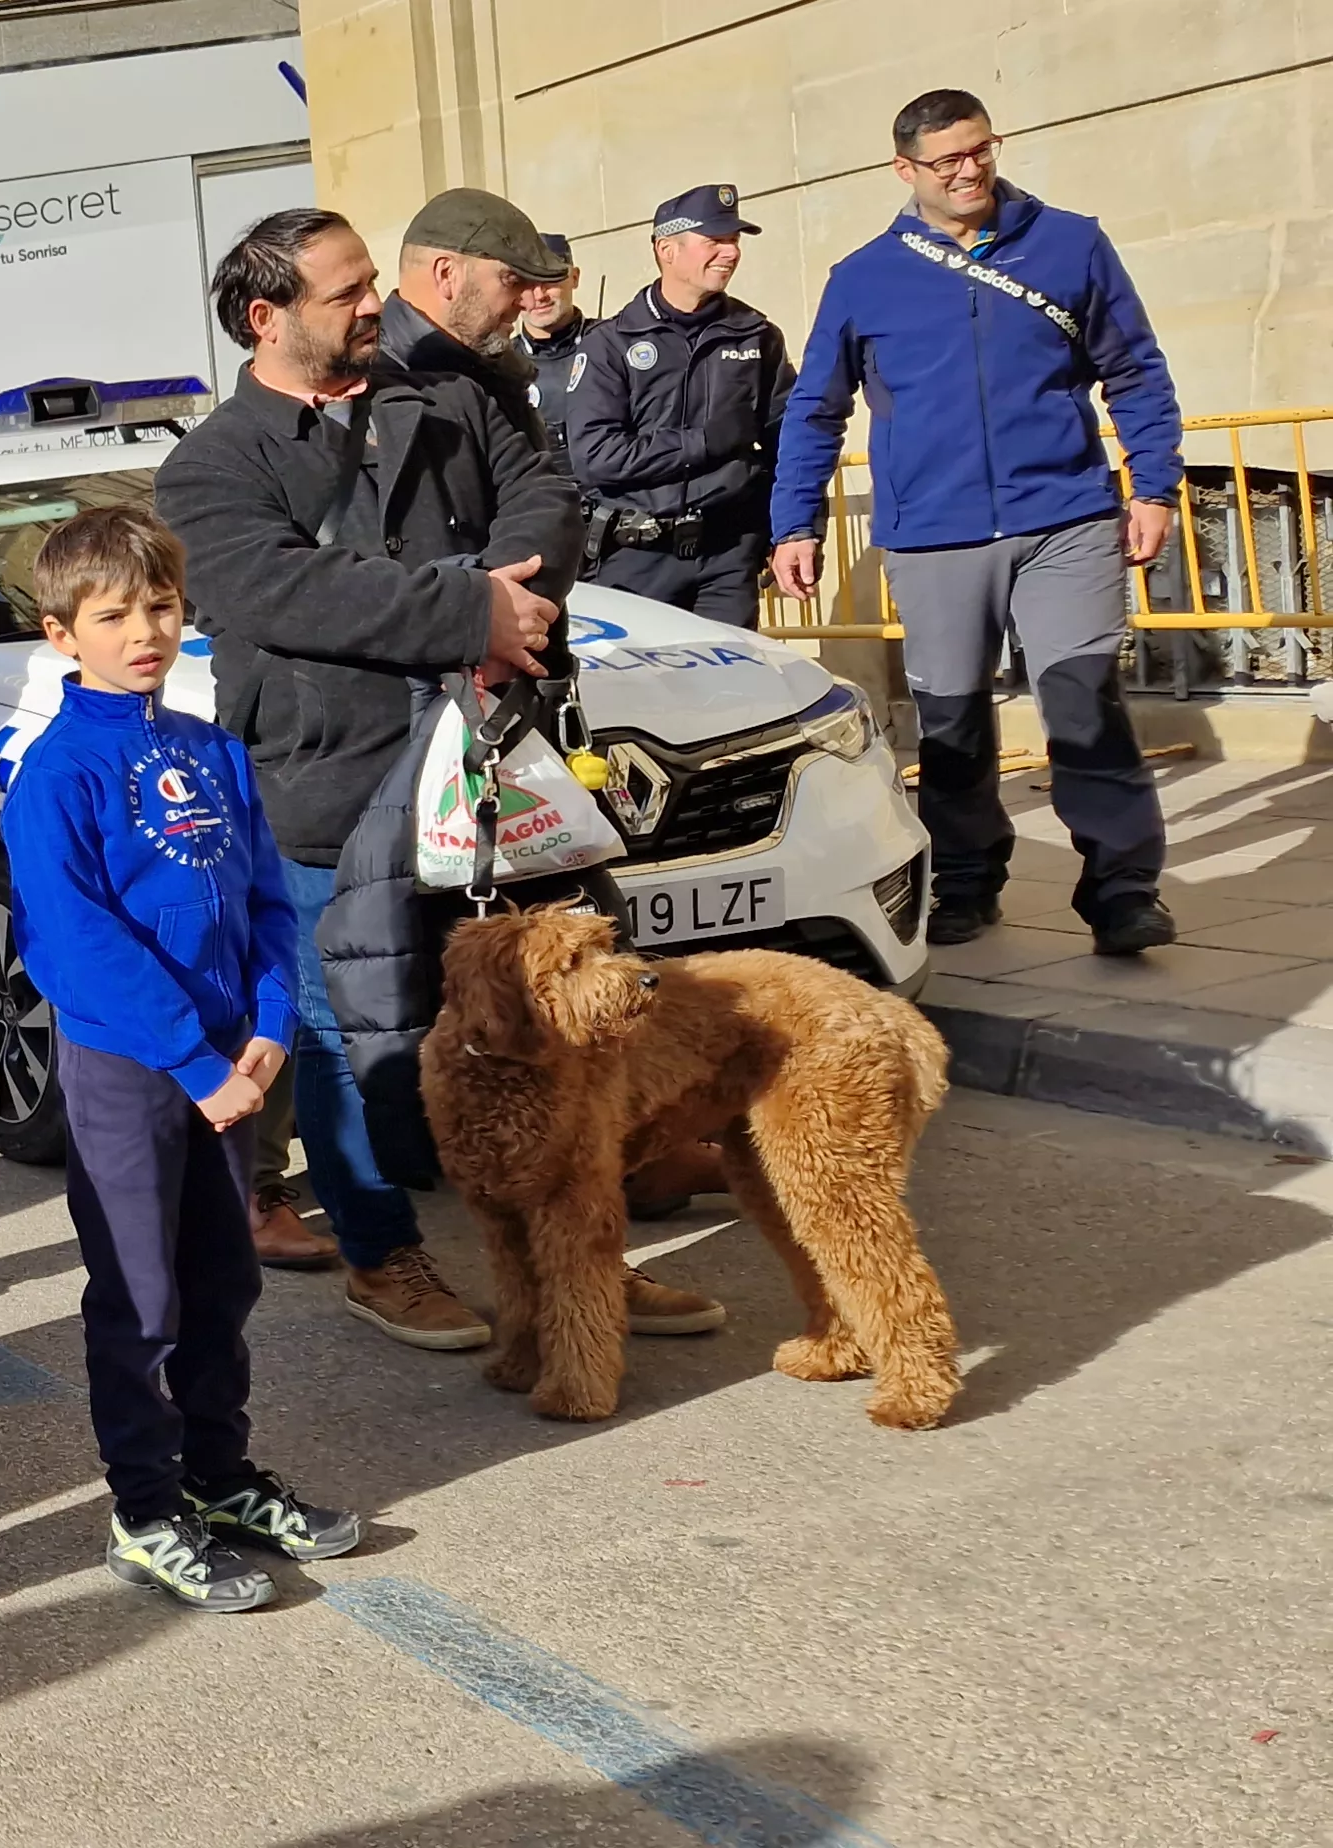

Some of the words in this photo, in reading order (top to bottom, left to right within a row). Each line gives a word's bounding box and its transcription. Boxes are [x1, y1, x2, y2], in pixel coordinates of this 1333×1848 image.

[1, 253, 14, 264] tu
[18, 244, 68, 262] Sonrisa
[902, 232, 945, 262] adidas
[967, 264, 1025, 298] adidas
[1045, 304, 1080, 338] adidas
[721, 349, 762, 360] POLICI
[493, 831, 572, 862] ECICLADO
[692, 878, 772, 931] LZF
